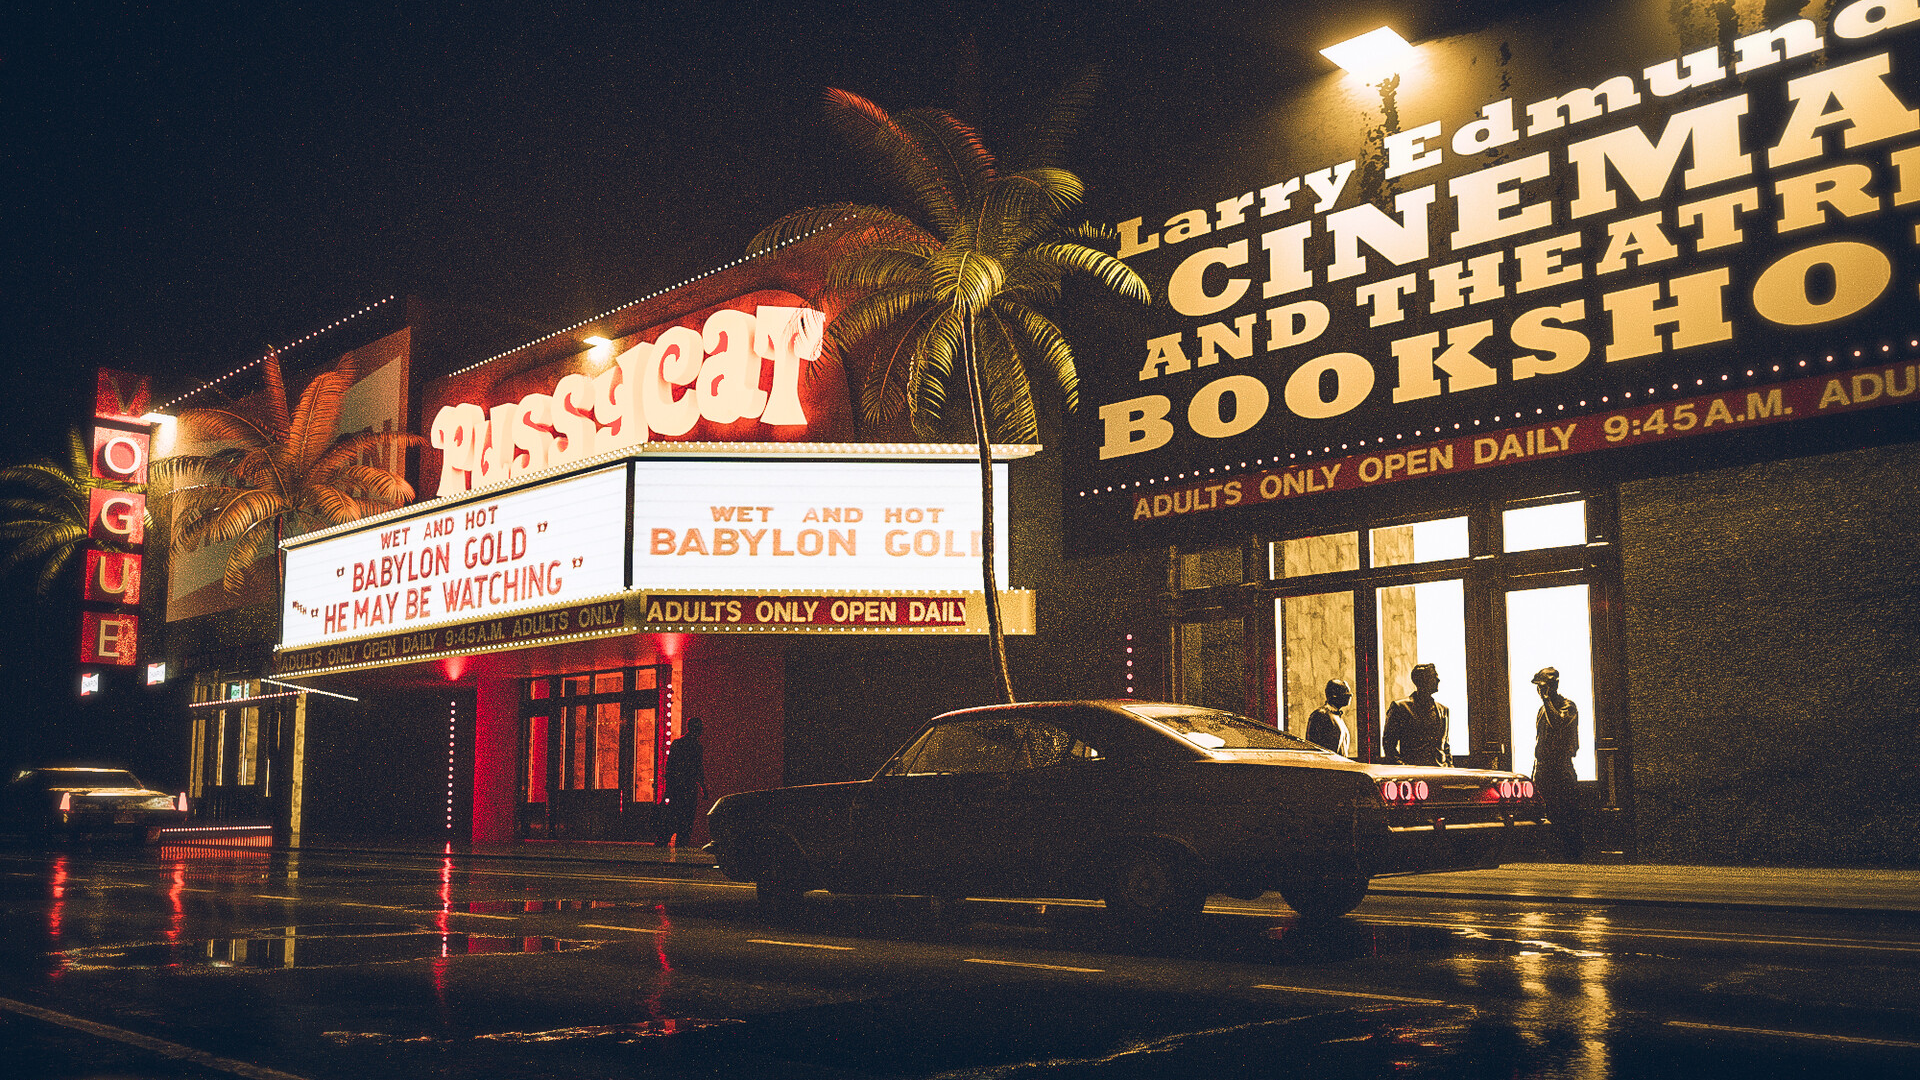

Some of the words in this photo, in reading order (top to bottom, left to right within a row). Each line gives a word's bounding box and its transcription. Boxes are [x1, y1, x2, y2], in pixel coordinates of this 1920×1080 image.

[1117, 159, 1357, 259] Larry
[1168, 52, 1919, 316] CINEMA
[1099, 224, 1920, 461] BOOKSHO
[1139, 300, 1330, 380] AND
[1133, 481, 1243, 520] ADULTS
[1259, 464, 1342, 500] ONLY
[1358, 445, 1453, 483] OPEN
[1473, 423, 1577, 465] DAILY
[1818, 364, 1920, 409] ADU
[97, 375, 145, 658] VOGUE
[381, 527, 410, 550] WET
[423, 516, 454, 540] AND
[465, 505, 498, 530] HOT
[650, 527, 857, 557] BABYLON
[710, 506, 775, 523] WET
[802, 507, 864, 523] AND
[884, 507, 945, 523] HOT
[282, 651, 322, 672] ADULTS
[328, 645, 358, 666] ONLY
[363, 638, 397, 660] OPEN
[402, 632, 438, 654] DAILY
[512, 611, 569, 638] ADULTS
[578, 603, 620, 628] ONLY
[353, 591, 399, 630] MAY
[405, 585, 432, 620] BE
[647, 600, 742, 622] ADULTS
[755, 601, 819, 622] ONLY
[830, 600, 897, 622] OPEN
